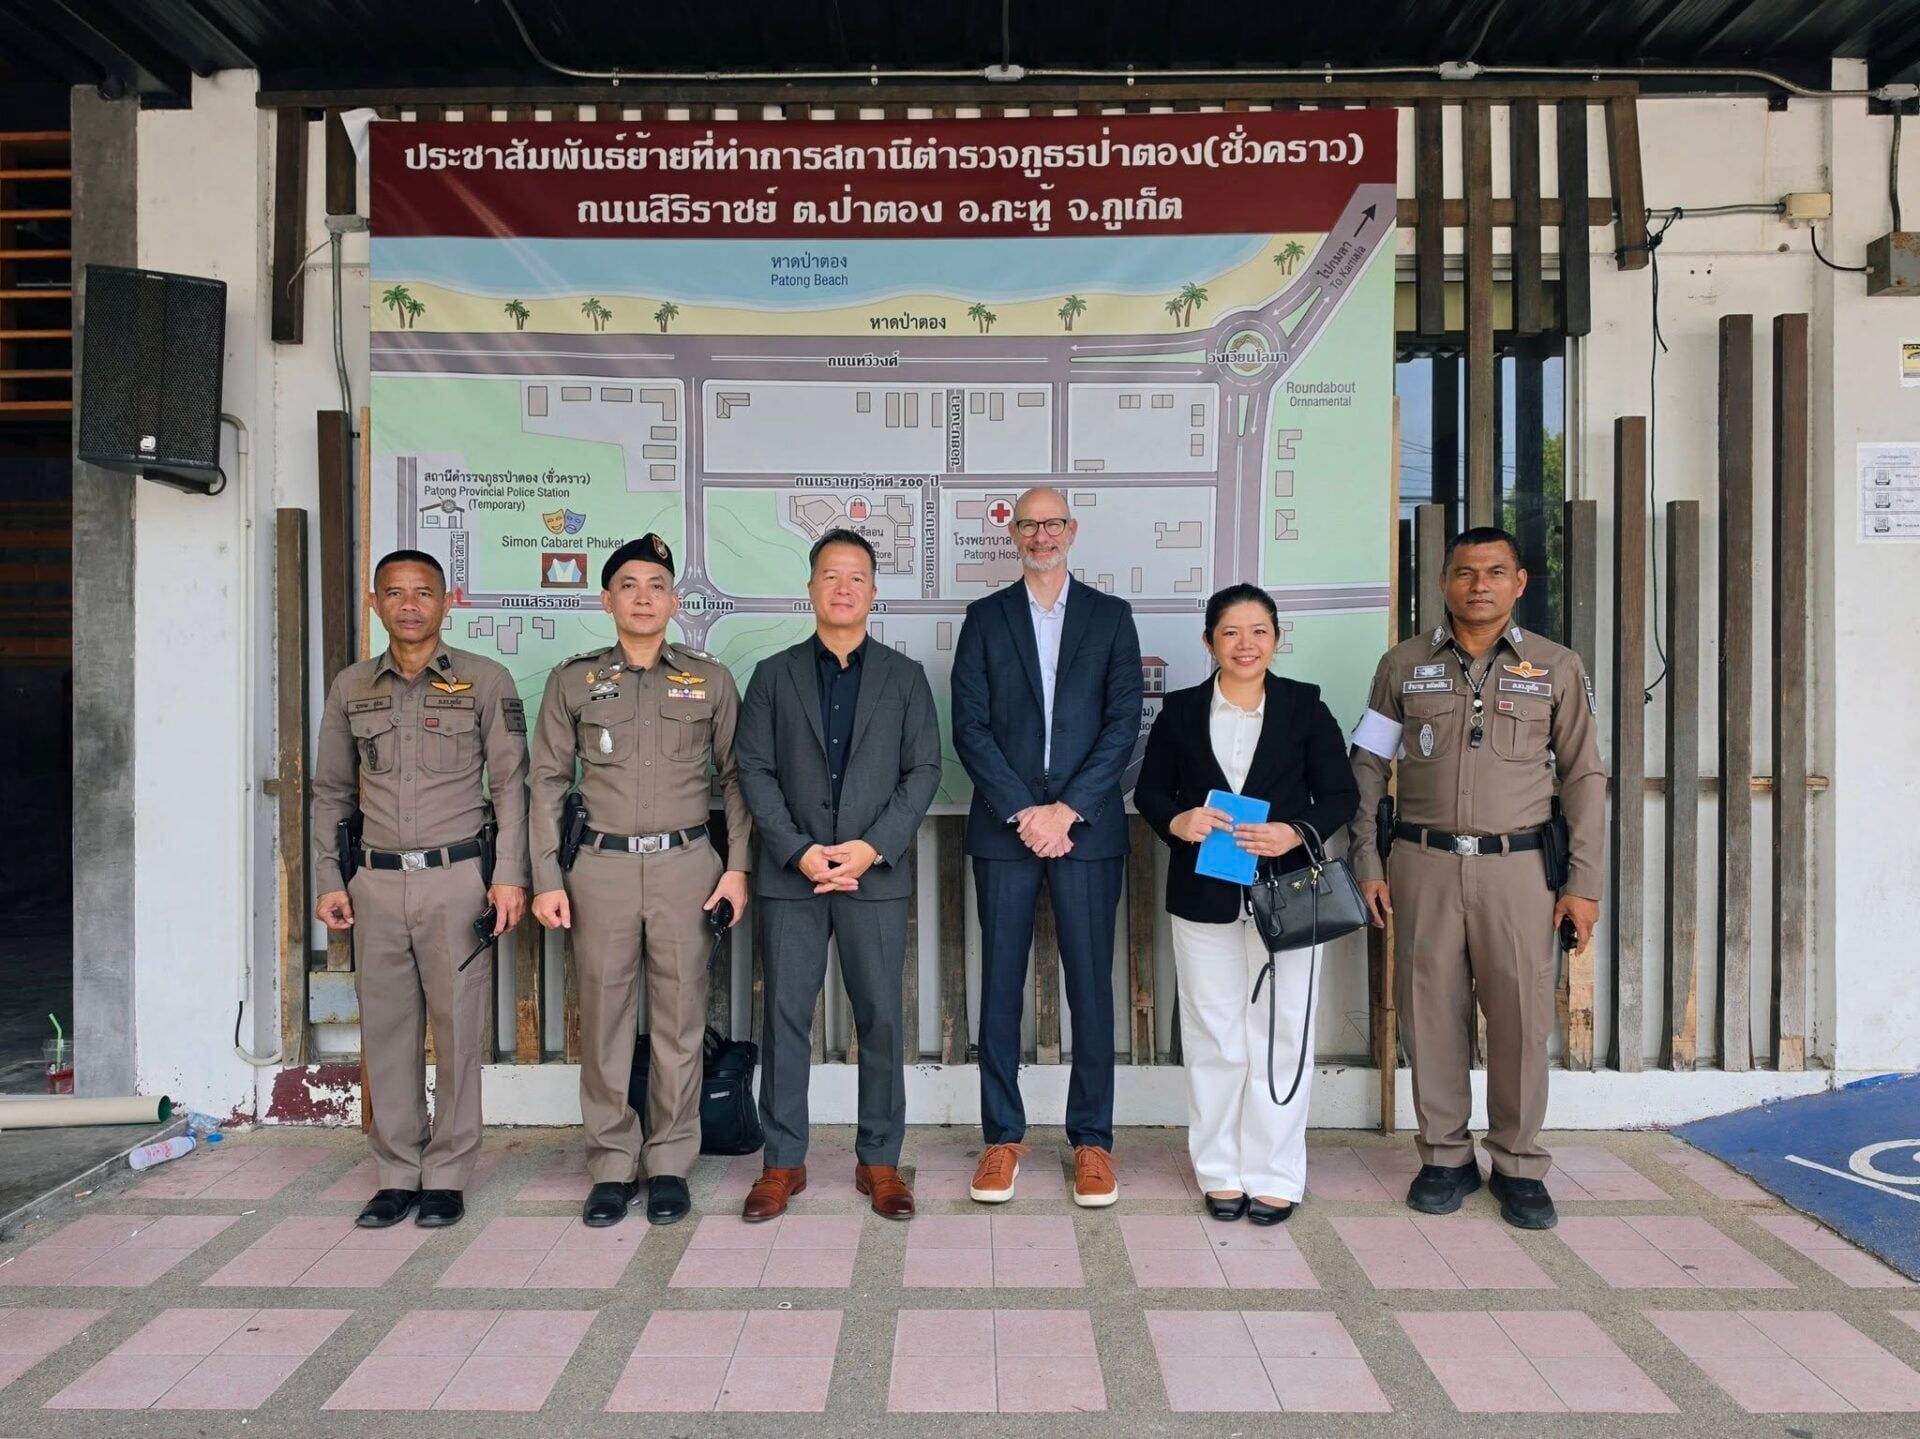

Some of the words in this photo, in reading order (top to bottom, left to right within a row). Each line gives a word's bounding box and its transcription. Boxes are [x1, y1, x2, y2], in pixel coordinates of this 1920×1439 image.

[405, 127, 1364, 178] ประชาสัมพันธ์ย้ายที่ทำการสถานีตำรวจภูธรป่าตอง(ชั่วคราว)
[577, 186, 778, 224] ถนนสิริราชย์
[792, 185, 943, 224] ต.ป่าตอง
[959, 183, 1052, 231] อ.กะทู้
[1069, 186, 1184, 231] จ.ภูเก็ต
[771, 251, 848, 269] หาดป่าตอง
[1329, 277, 1343, 289] To
[1339, 246, 1366, 278] Kamala
[771, 274, 811, 288] Patong
[814, 273, 849, 286] Beach
[870, 312, 947, 330] หาดป่าตอง
[828, 351, 899, 368] ถนนทวีวงศ์
[1208, 348, 1289, 363] วงเวียนโลมา
[1286, 381, 1356, 394] Roundabout
[950, 395, 961, 467] ซอยบางลา
[899, 478, 924, 487] 200
[930, 474, 940, 487] ปี
[424, 486, 457, 497] Patong
[459, 486, 505, 497] Provincial
[507, 487, 535, 497] Police
[537, 487, 570, 498] Station
[468, 499, 526, 512] (Temporary)
[502, 536, 537, 548] Simon
[541, 537, 583, 549] Cabaret
[587, 537, 624, 549] Phuket
[964, 549, 995, 561] Patong
[502, 594, 580, 608] ถนนสิริราชย์
